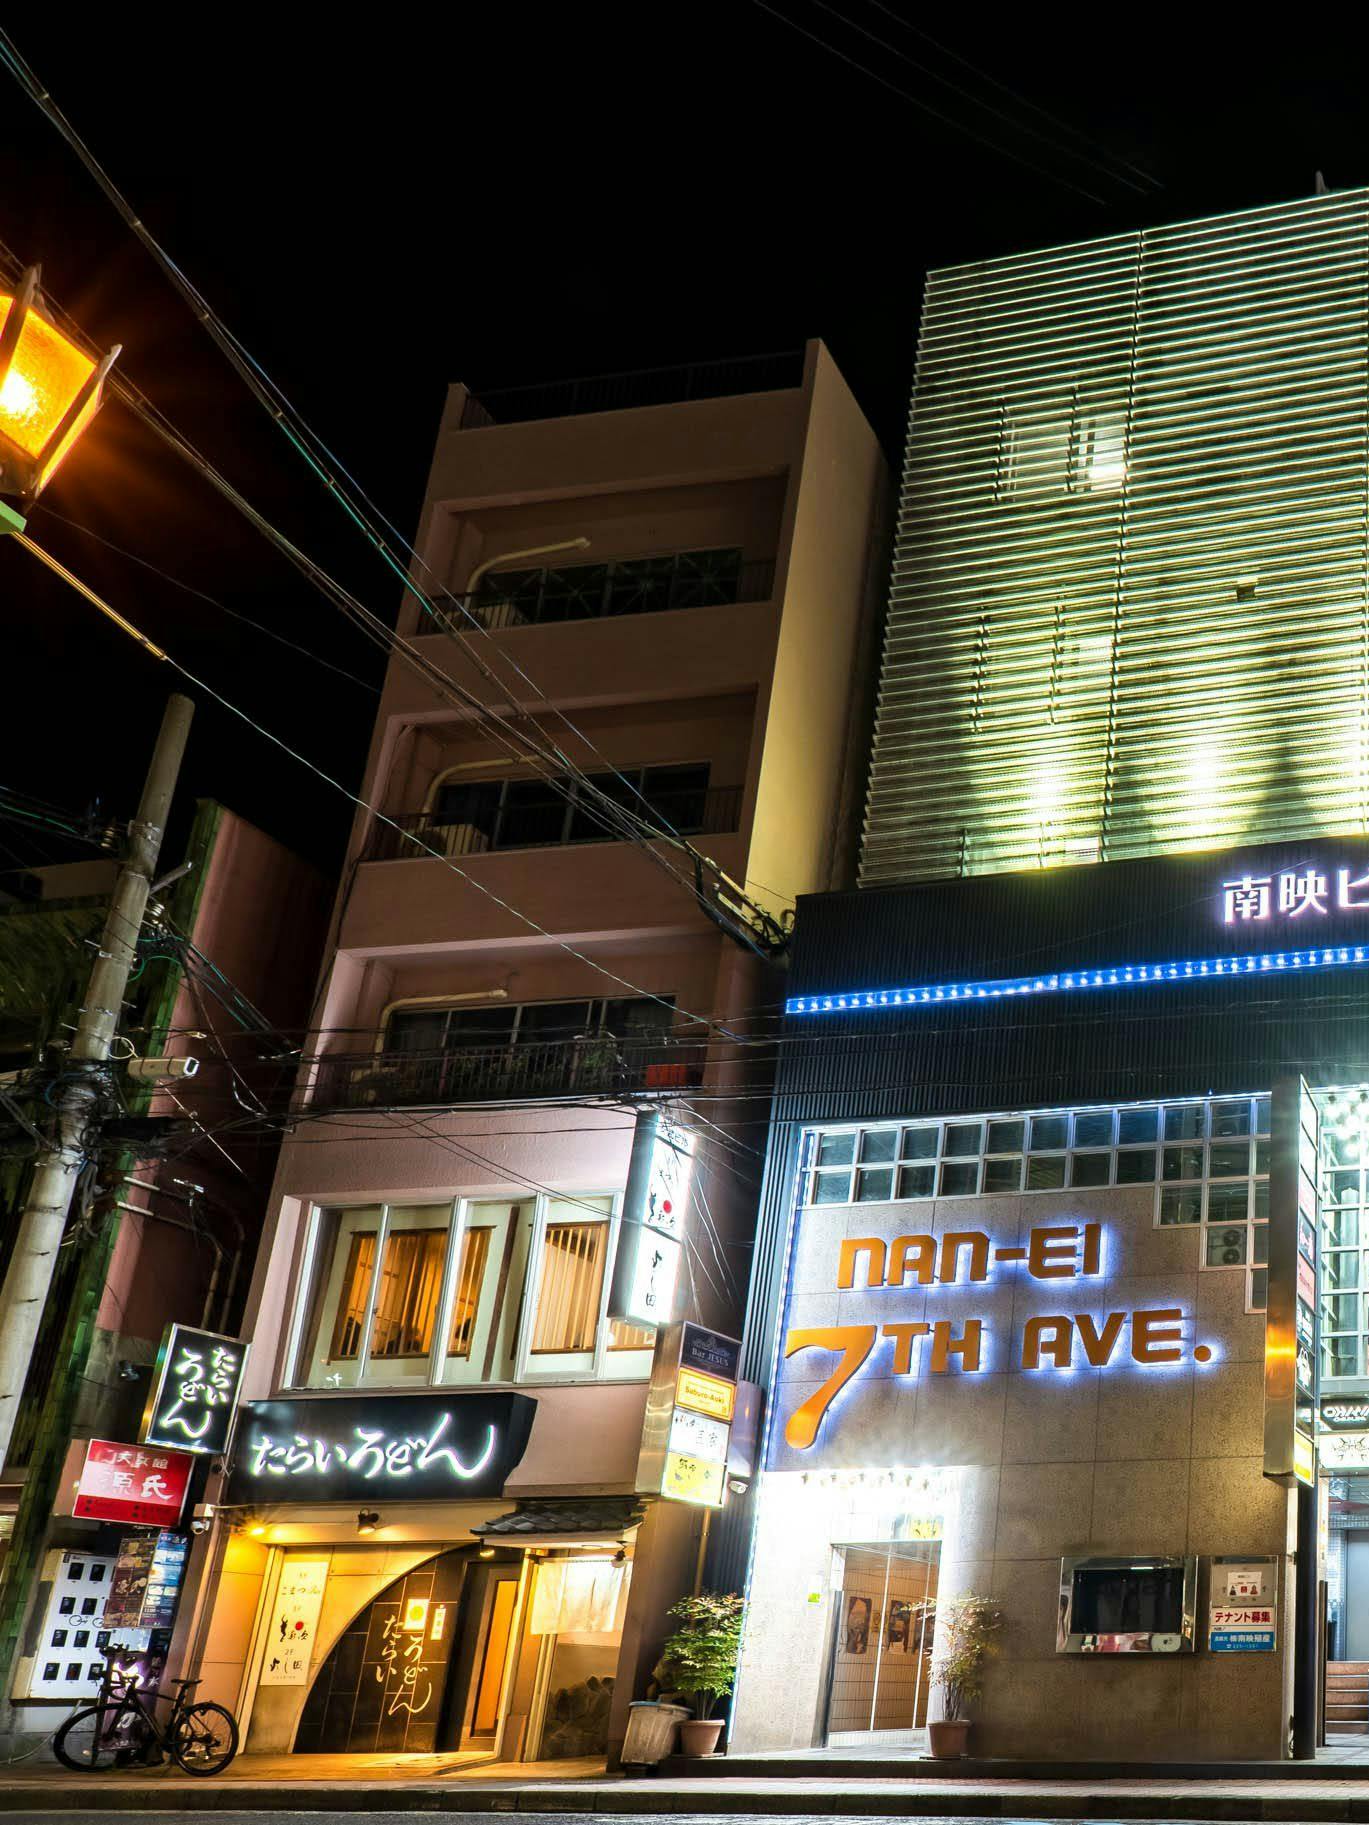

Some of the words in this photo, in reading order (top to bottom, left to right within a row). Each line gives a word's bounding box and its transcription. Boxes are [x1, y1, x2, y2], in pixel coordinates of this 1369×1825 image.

[785, 1319, 983, 1450] 7TH
[1022, 1307, 1213, 1370] AVE.
[251, 1412, 496, 1479] たらいうどん
[1215, 1611, 1271, 1623] テナント募集
